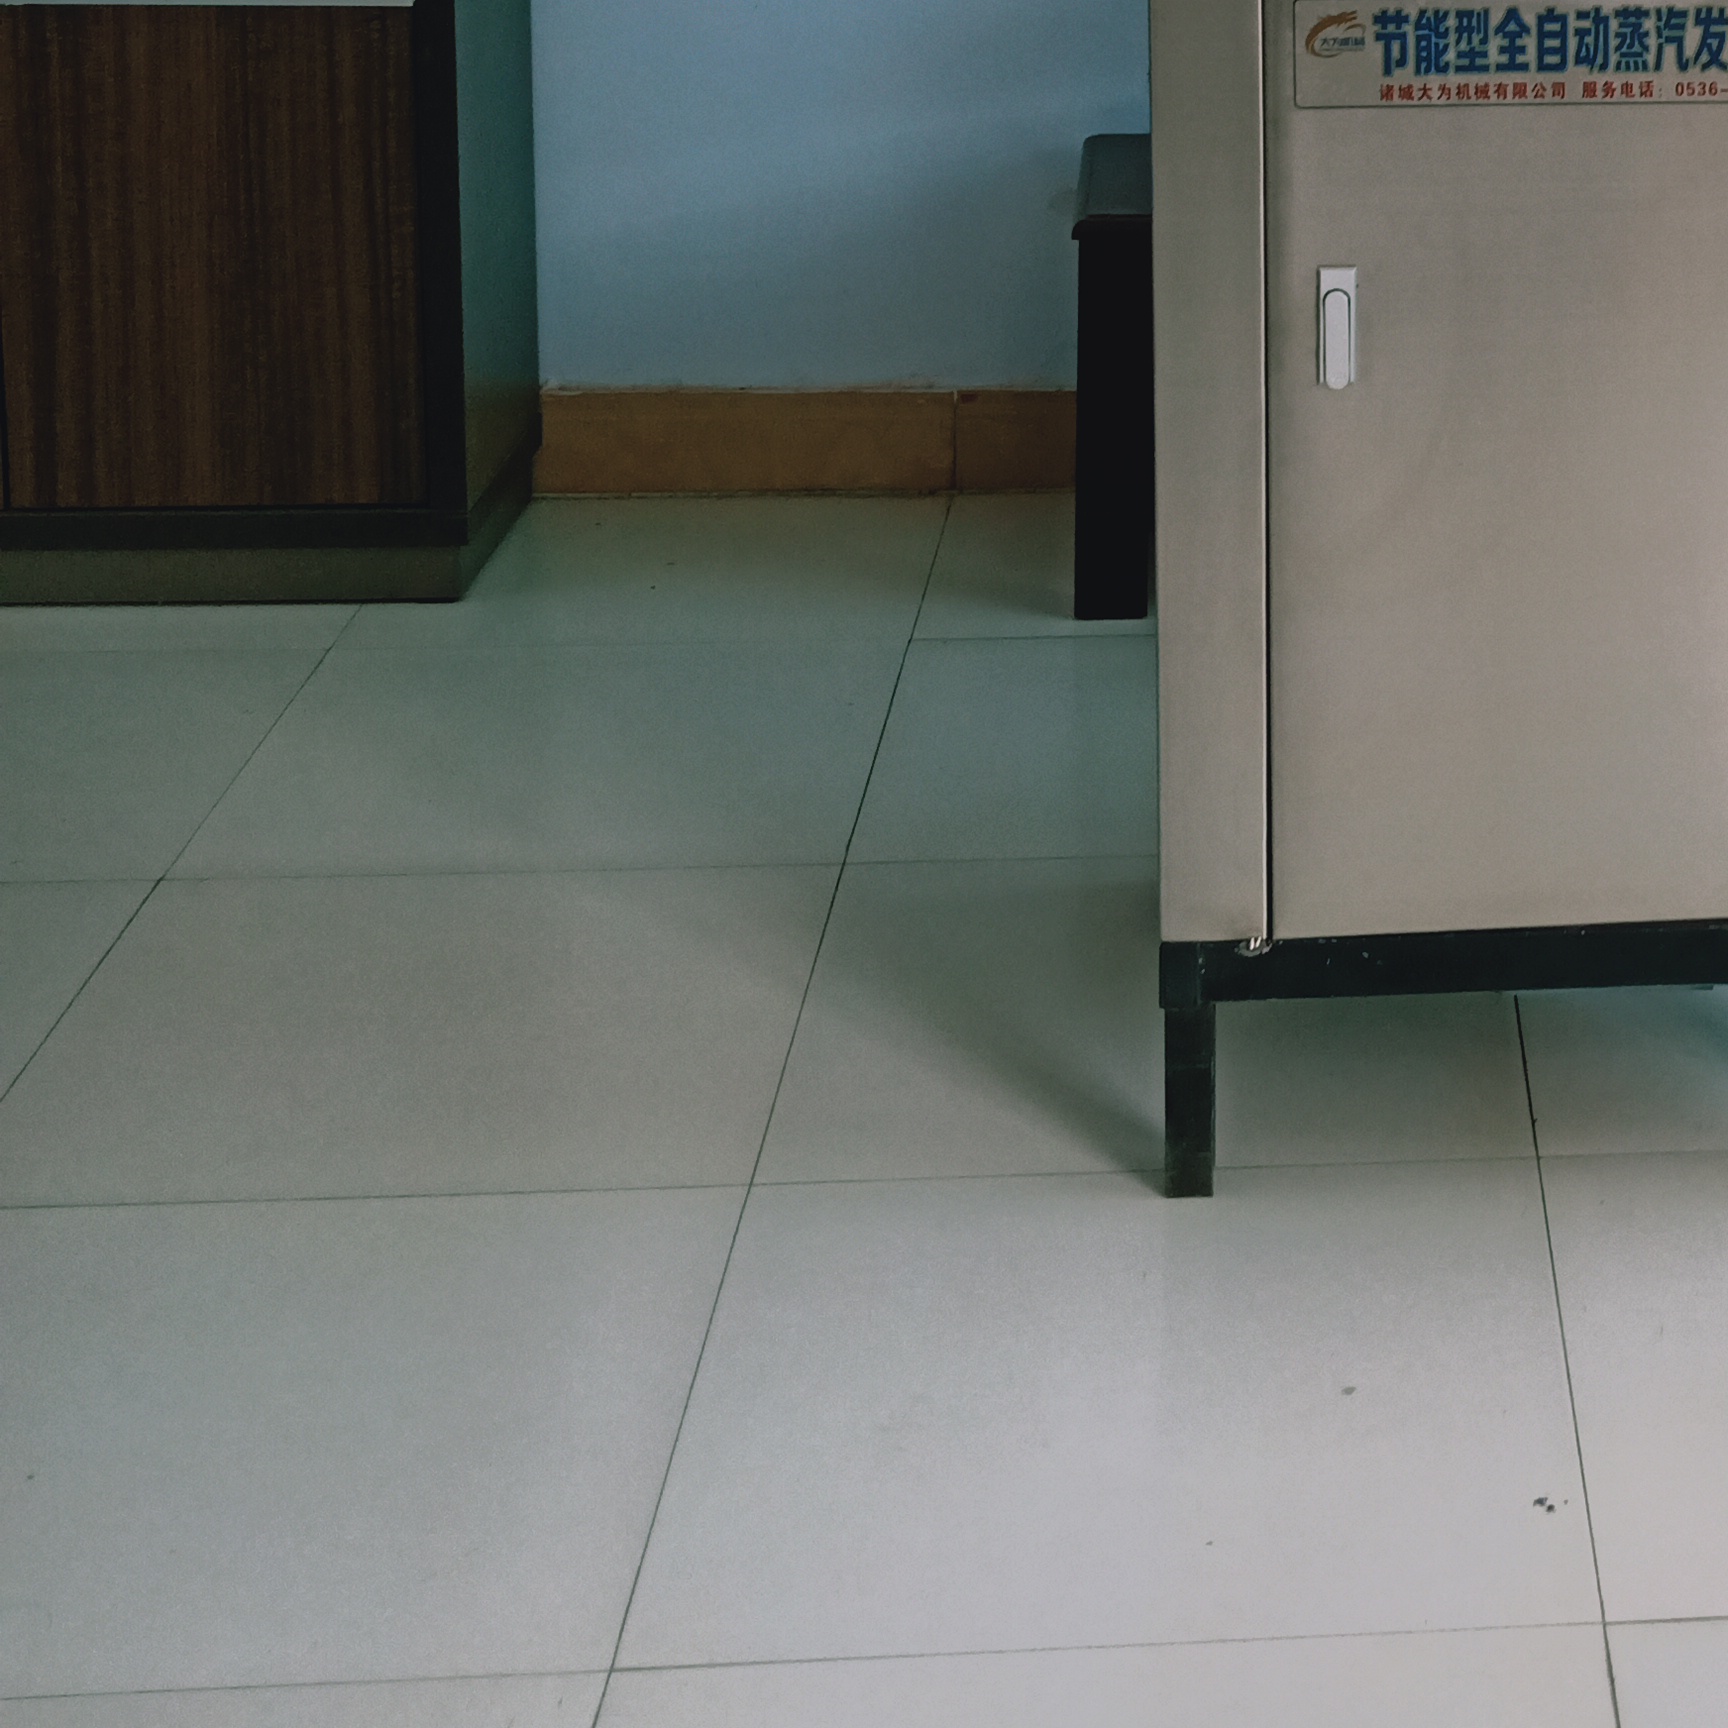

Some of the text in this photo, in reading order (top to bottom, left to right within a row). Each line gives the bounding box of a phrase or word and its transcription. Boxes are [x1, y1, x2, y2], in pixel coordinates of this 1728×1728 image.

[1379, 81, 1566, 102] 诸城大为机械有限公司
